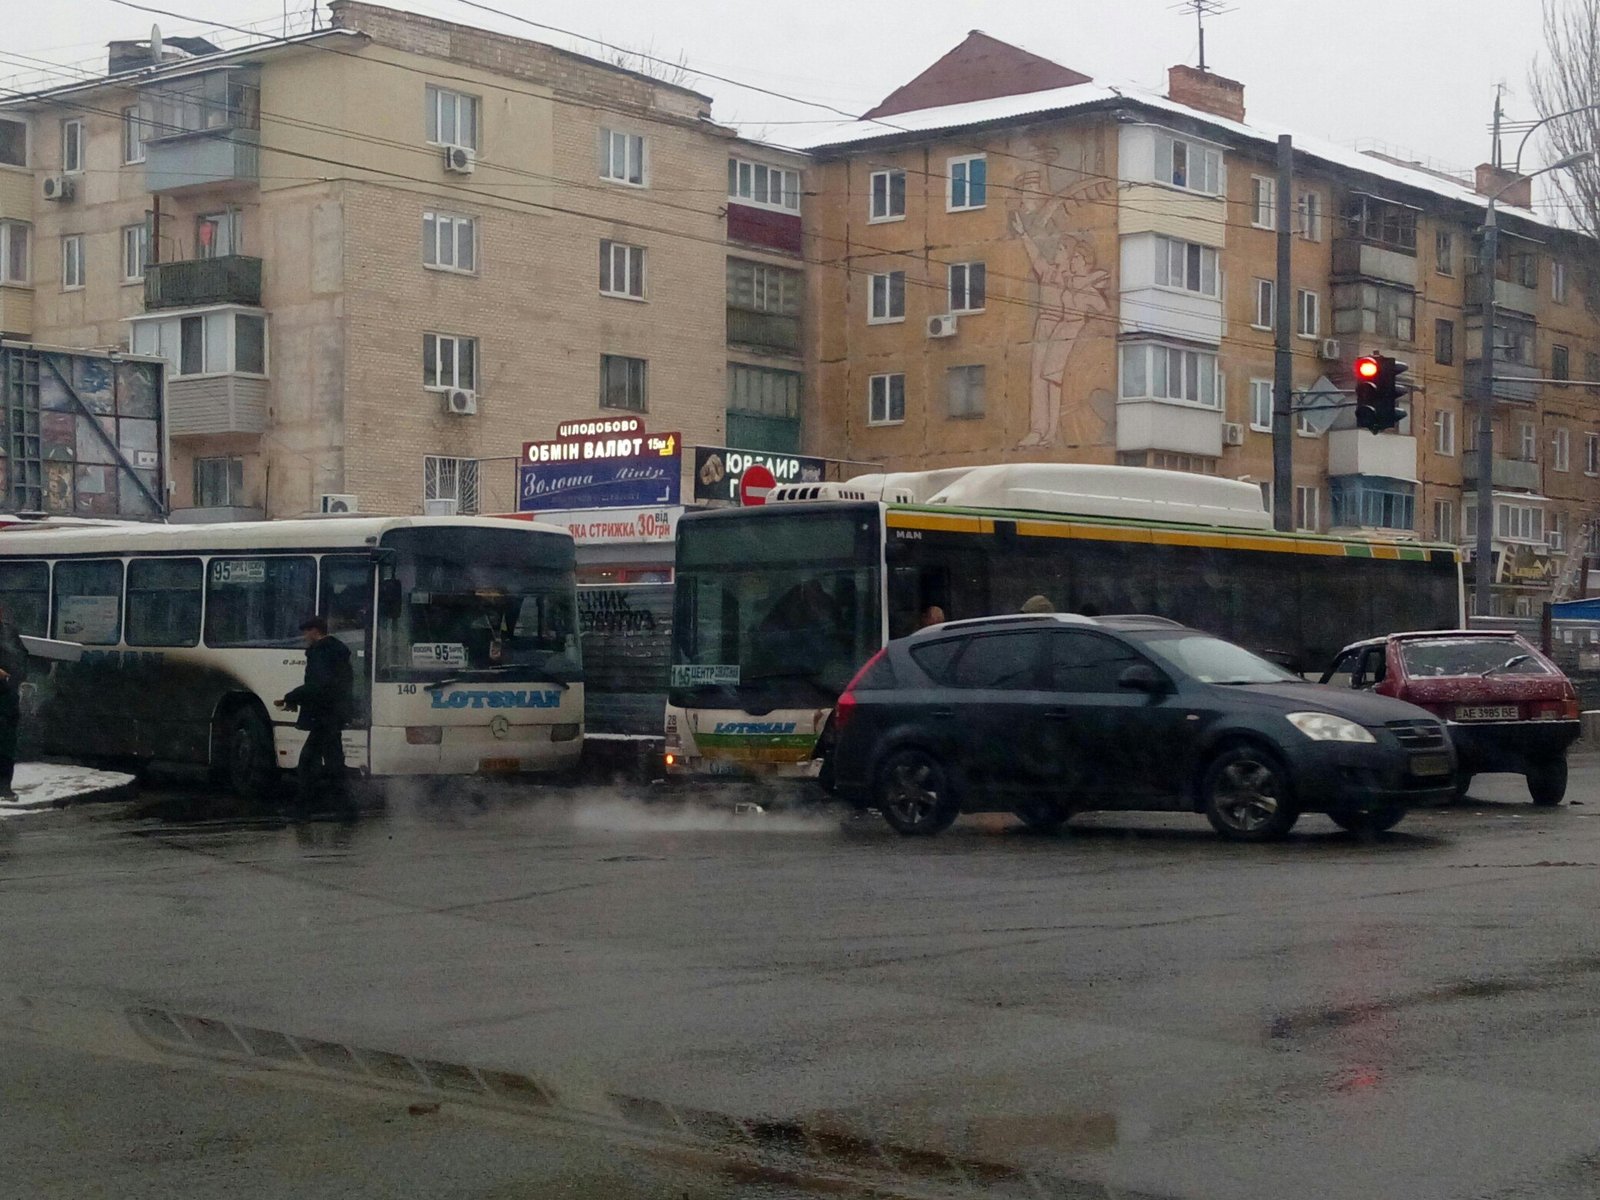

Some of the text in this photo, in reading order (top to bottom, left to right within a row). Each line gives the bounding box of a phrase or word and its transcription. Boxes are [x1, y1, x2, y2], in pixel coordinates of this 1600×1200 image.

[560, 420, 638, 436] ЦІЛОДОБОВО
[528, 442, 579, 462] ОБМІН
[583, 438, 643, 459] ВАЛЮТ
[725, 452, 800, 479] ЮВЛИР
[589, 522, 635, 537] СТРИЖКА
[638, 513, 655, 536] 30
[654, 524, 670, 539] грн
[896, 530, 922, 540] MAN
[214, 560, 231, 580] 95
[434, 644, 449, 660] 95
[398, 684, 416, 695] 140
[430, 690, 562, 708] LOTSMAN
[667, 714, 677, 725] 28
[1463, 708, 1476, 718] AE
